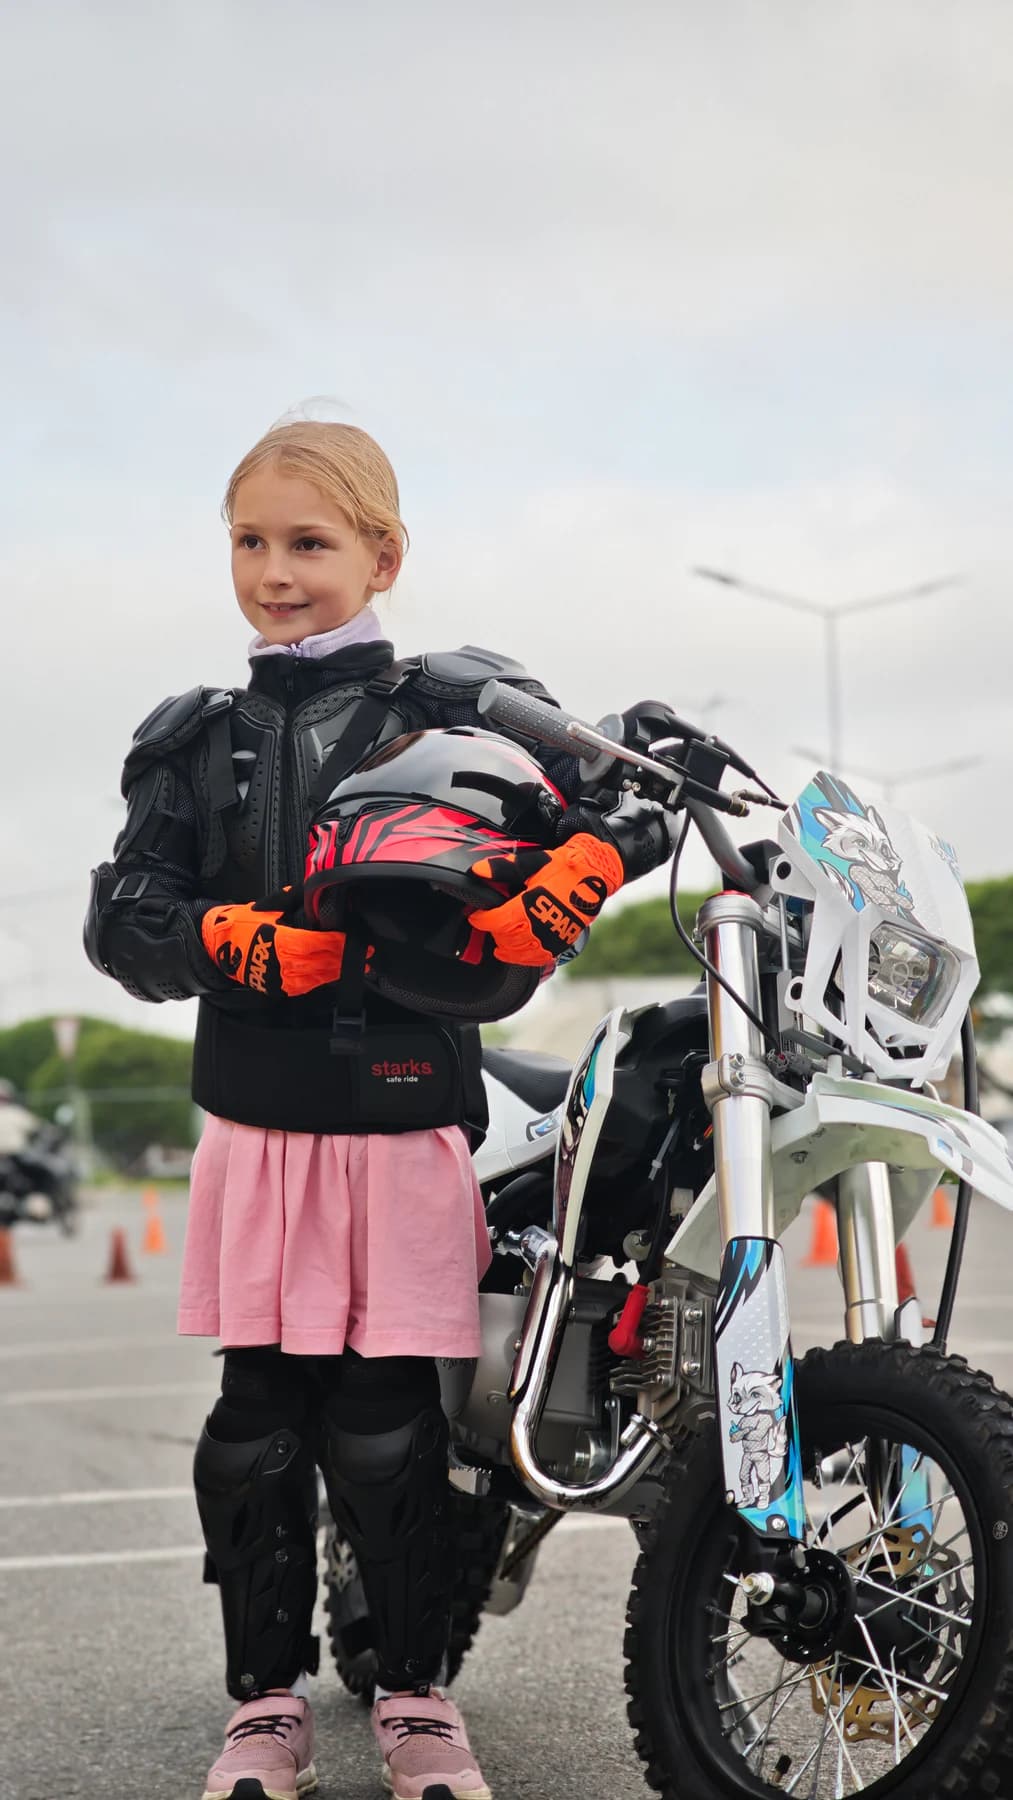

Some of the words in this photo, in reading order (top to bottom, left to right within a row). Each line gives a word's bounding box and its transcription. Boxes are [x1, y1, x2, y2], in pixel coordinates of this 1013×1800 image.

[529, 895, 581, 945] SPAR
[248, 933, 273, 994] PARX
[371, 1059, 433, 1076] starks
[403, 1075, 419, 1083] ride
